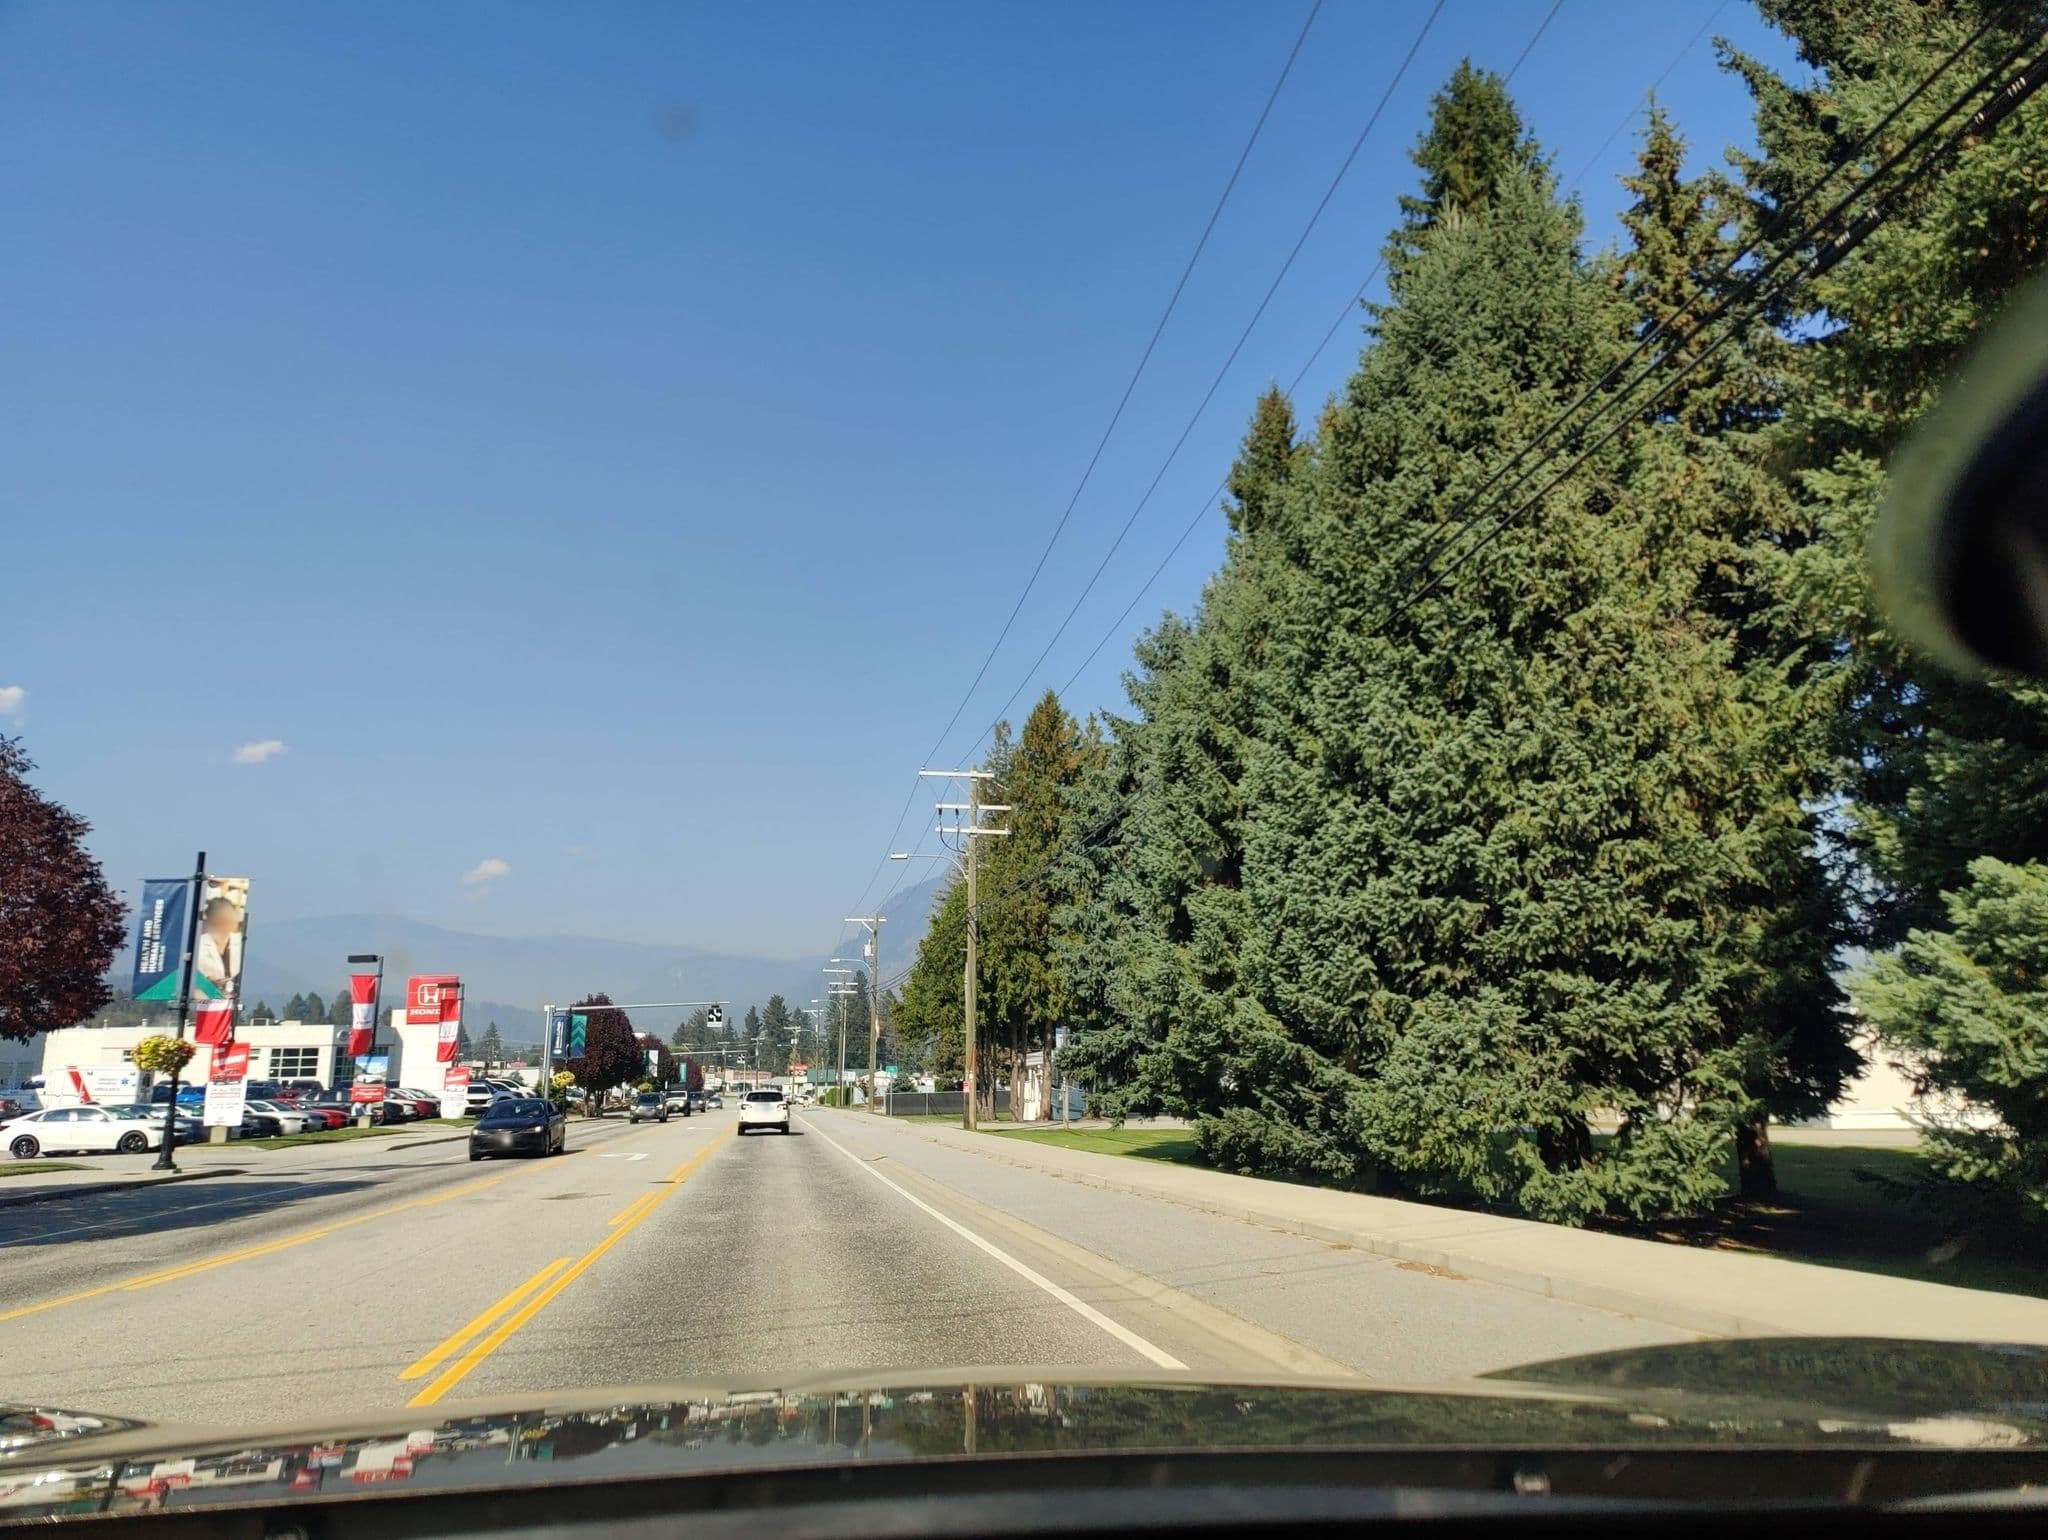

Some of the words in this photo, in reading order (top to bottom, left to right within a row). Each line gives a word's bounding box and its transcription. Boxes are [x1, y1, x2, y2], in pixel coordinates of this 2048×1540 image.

[144, 920, 153, 938] AND
[153, 899, 164, 940] SERVICES
[139, 940, 151, 973] HEALTH
[148, 942, 160, 973] HUMAN
